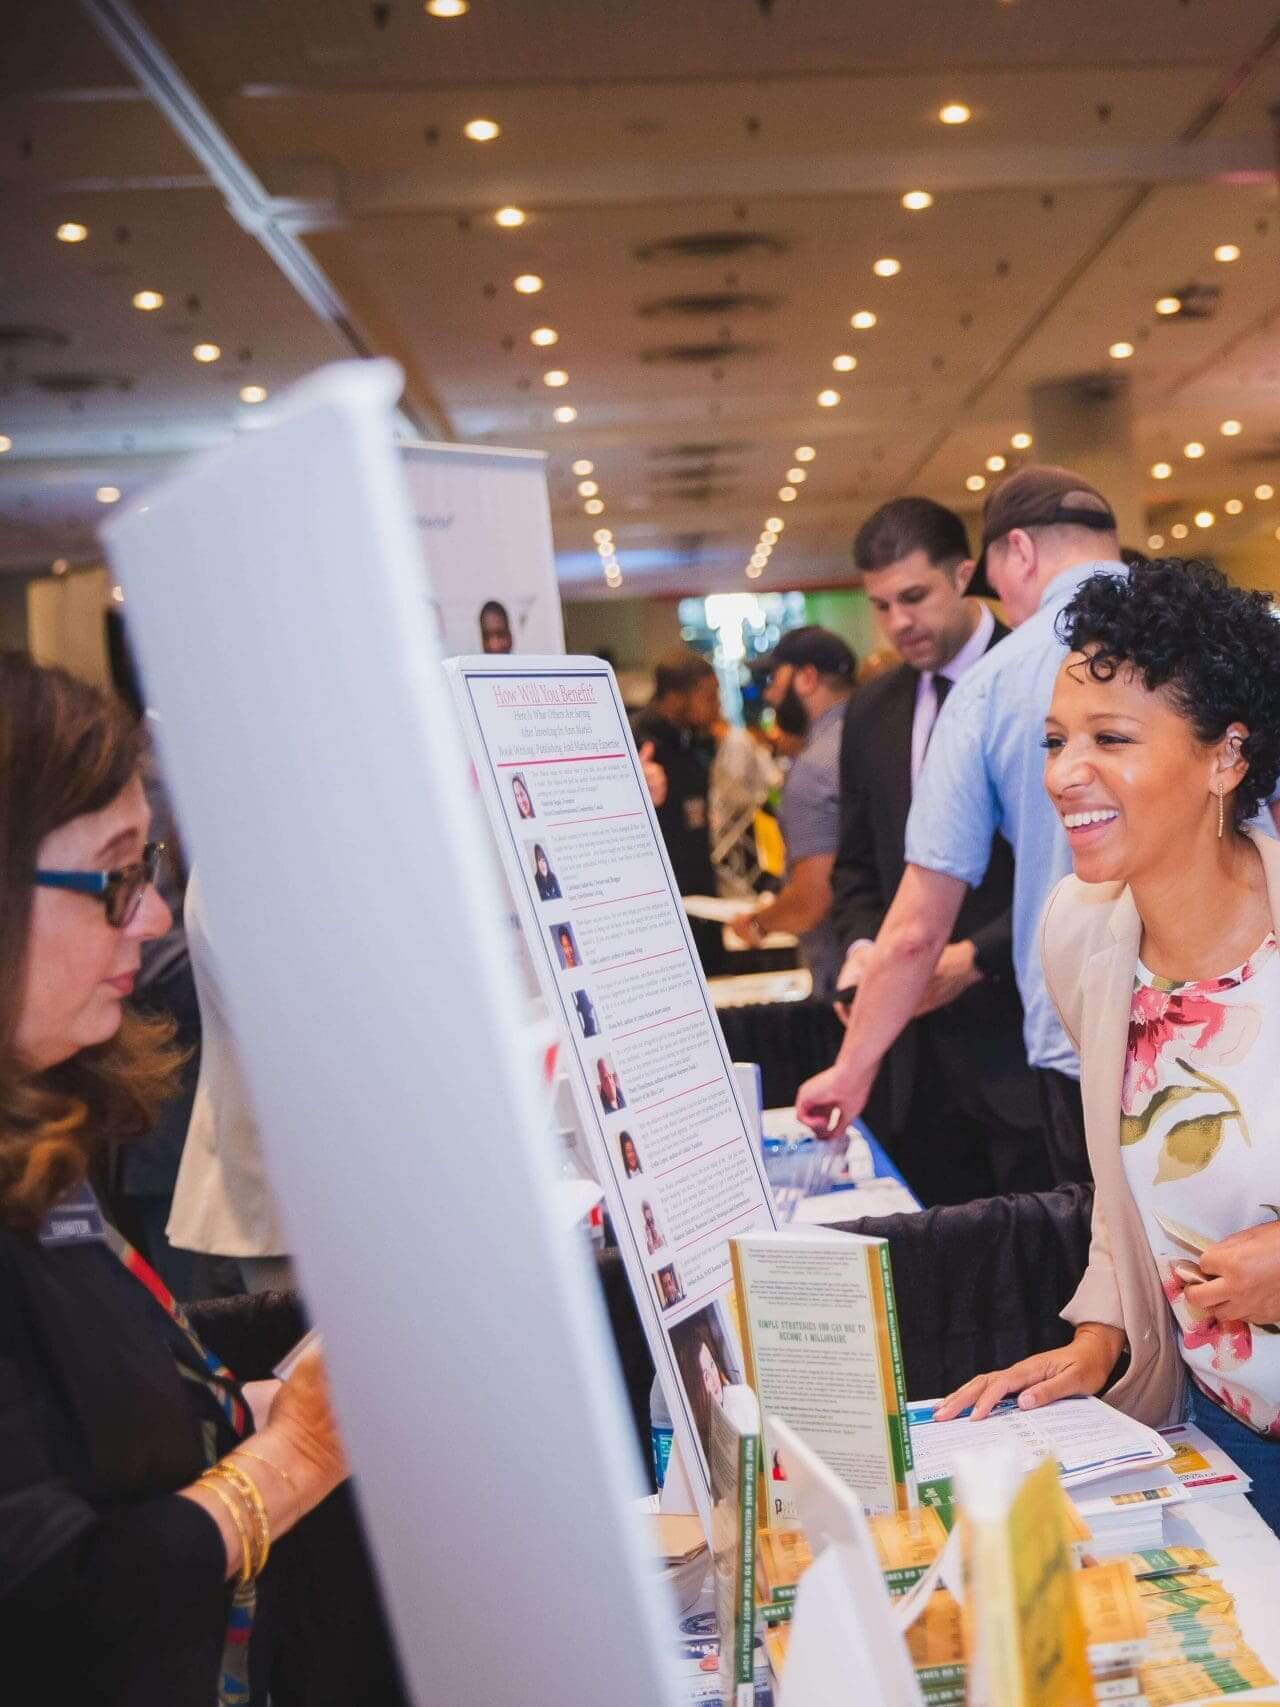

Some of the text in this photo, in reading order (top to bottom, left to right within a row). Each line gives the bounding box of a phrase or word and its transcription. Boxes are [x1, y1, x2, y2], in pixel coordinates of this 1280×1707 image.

[493, 684, 516, 704] How
[517, 681, 540, 703] Will
[540, 684, 559, 703] You
[744, 1507, 753, 1563] MILLIONAIRES
[744, 1564, 752, 1576] DO
[744, 1578, 752, 1598] THAT
[743, 1599, 751, 1621] MOST
[743, 1622, 751, 1653] PEOPLE
